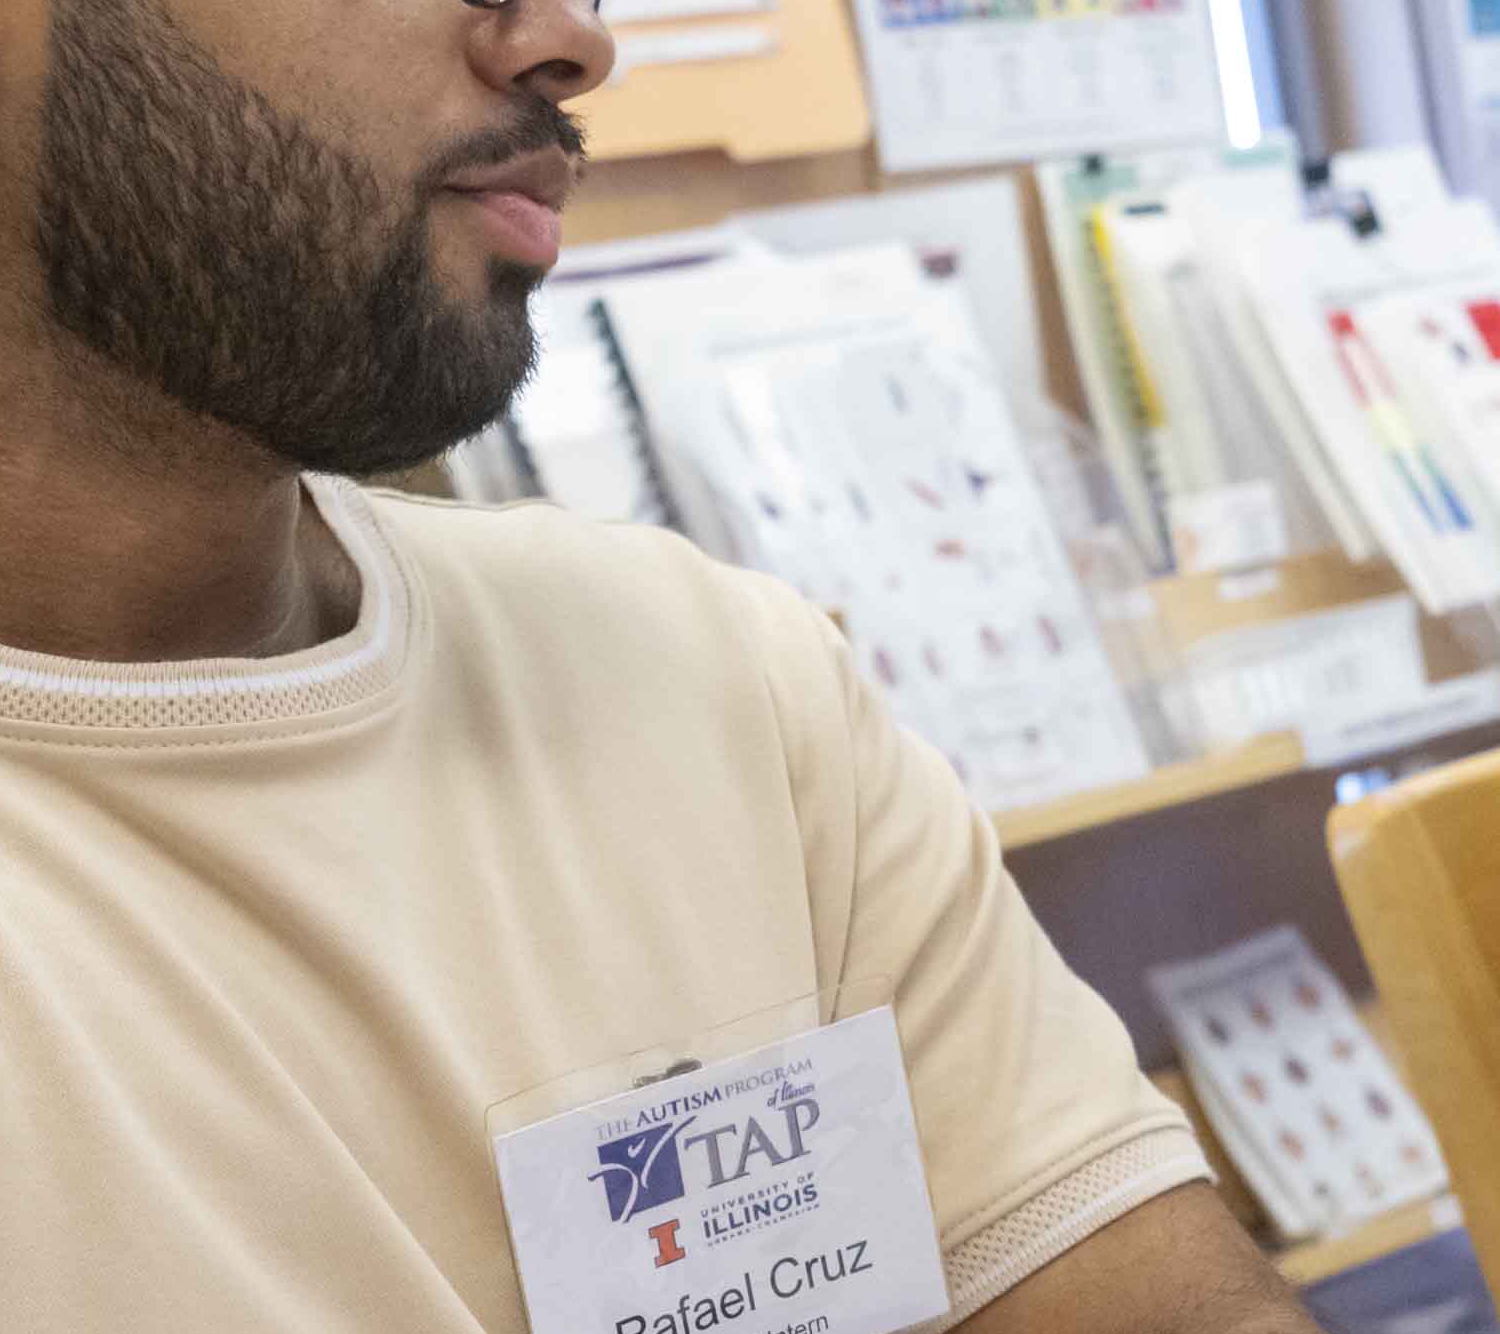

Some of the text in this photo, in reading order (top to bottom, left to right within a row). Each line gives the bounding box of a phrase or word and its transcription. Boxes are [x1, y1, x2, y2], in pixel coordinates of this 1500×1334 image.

[635, 1087, 723, 1127] AUTISM
[724, 1058, 814, 1099] PROGRAM
[684, 1098, 821, 1188] TAP
[700, 1170, 815, 1218] UNIVERSITY OF
[703, 1183, 819, 1239] ILLINOIS
[770, 1240, 873, 1299] Cruz
